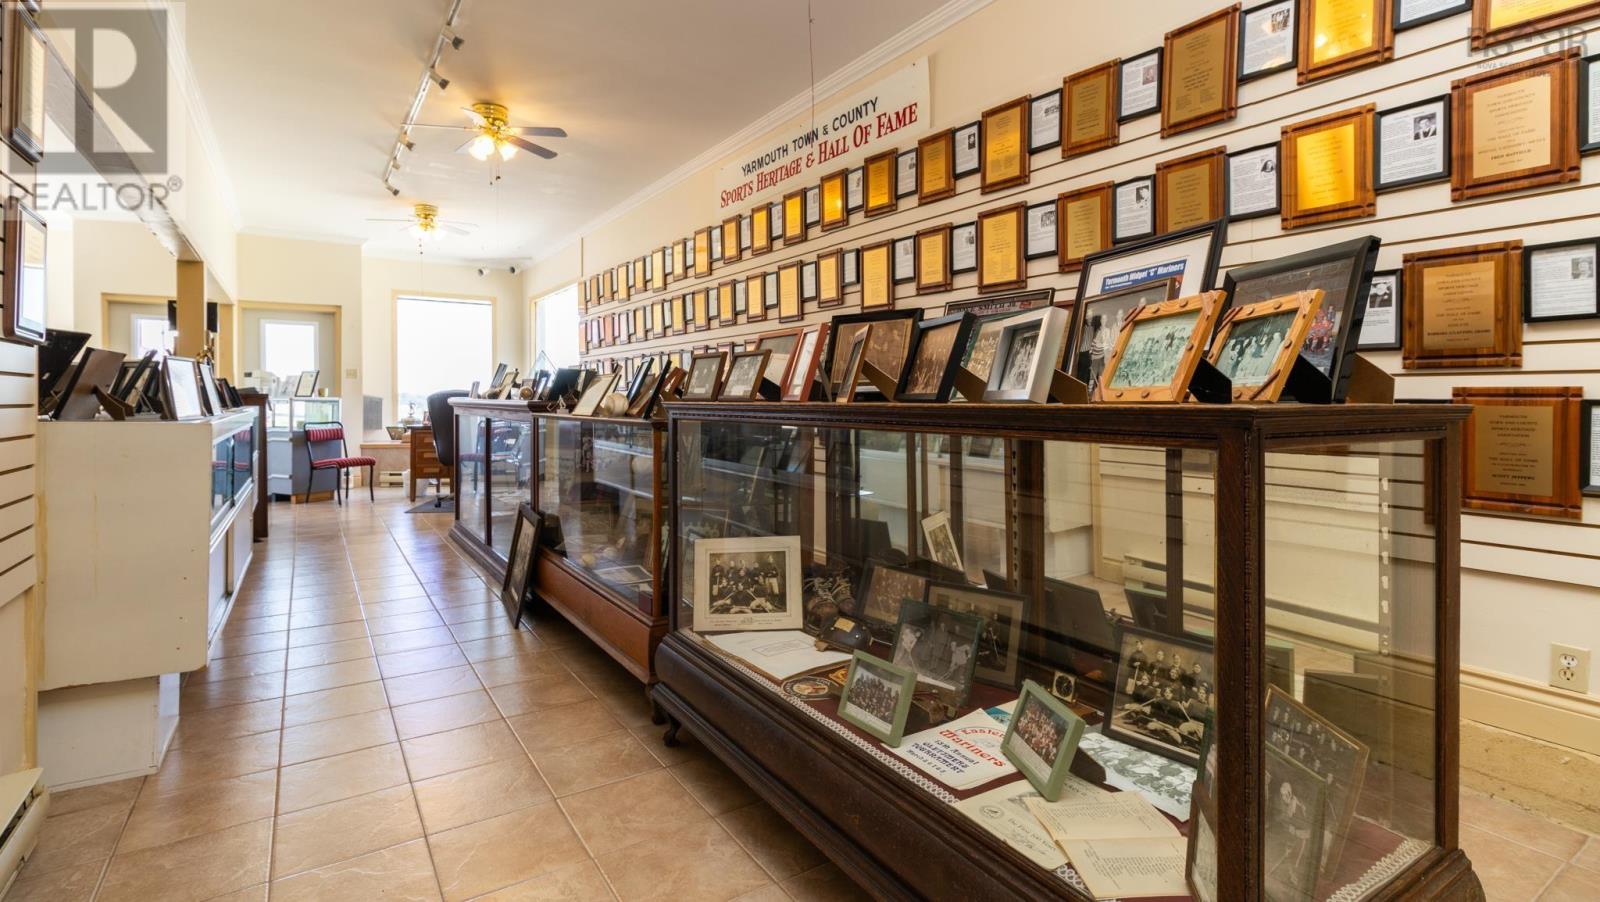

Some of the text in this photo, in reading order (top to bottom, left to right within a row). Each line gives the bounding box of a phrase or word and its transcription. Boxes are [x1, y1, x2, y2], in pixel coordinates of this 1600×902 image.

[720, 180, 754, 209] SPORTS
[756, 157, 803, 193] HERITAGE
[805, 152, 815, 169] &
[817, 135, 850, 165] HALL
[876, 101, 918, 140] FAME
[741, 96, 878, 177] YARMOUTH TOWN & COUNTY
[1105, 274, 1130, 287] Yarmouth
[1129, 270, 1148, 282] Widget
[1157, 262, 1185, 275] Mariners
[939, 729, 1006, 767] Mariners
